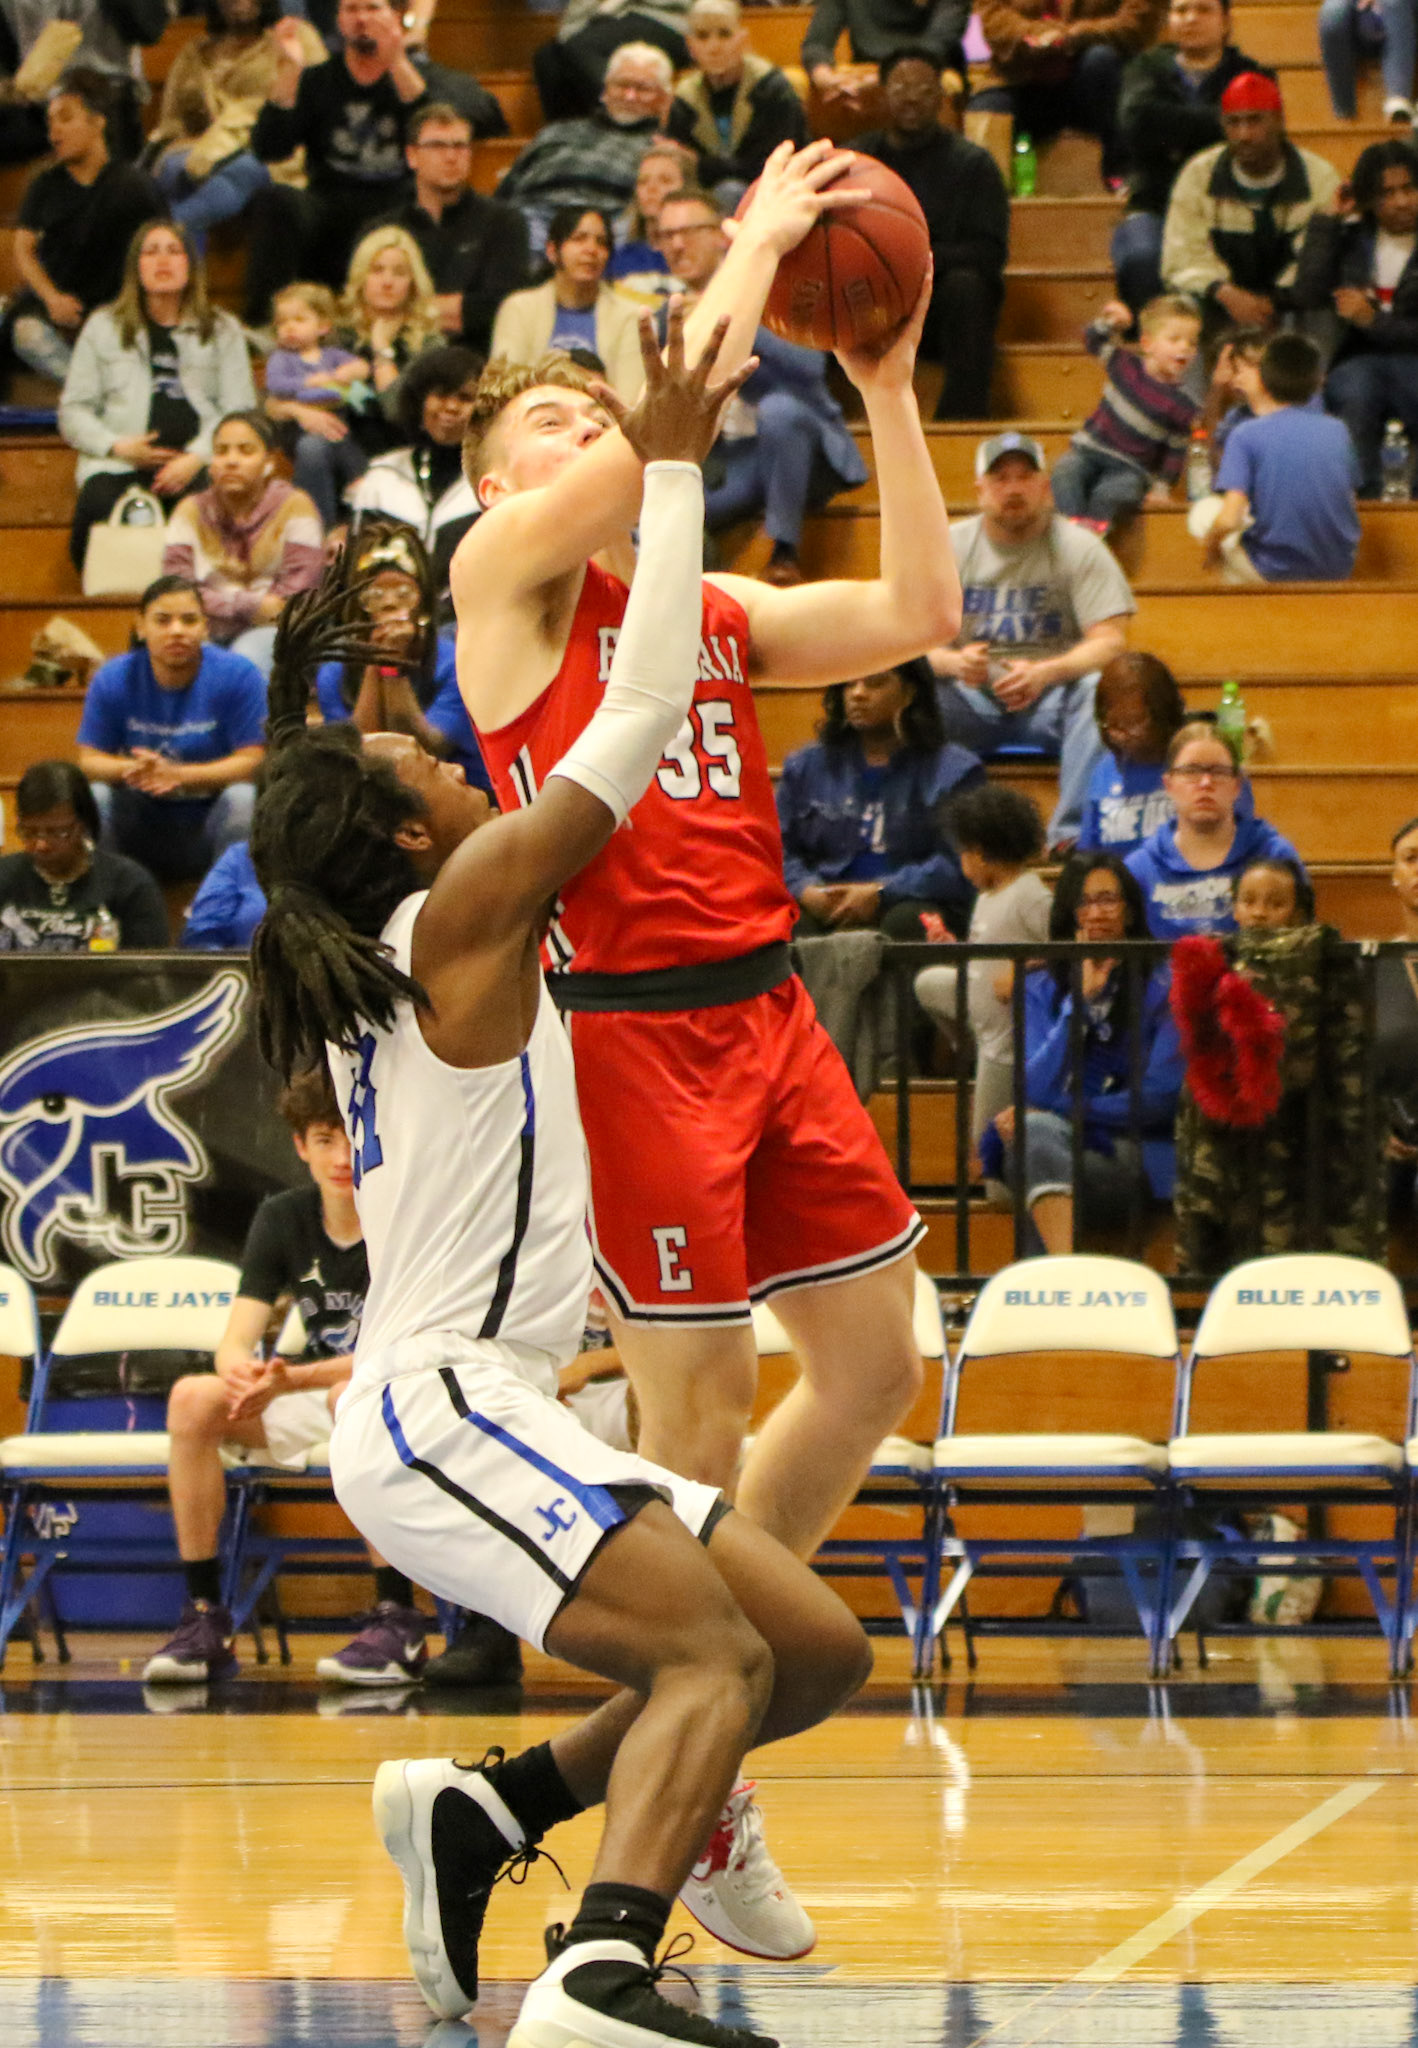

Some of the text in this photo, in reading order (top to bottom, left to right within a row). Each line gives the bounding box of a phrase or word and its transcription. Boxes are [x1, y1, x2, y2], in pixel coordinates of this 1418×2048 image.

[598, 626, 745, 685] ERIA
[656, 698, 742, 800] 35
[56, 1143, 180, 1253] JC
[650, 1225, 694, 1293] E
[93, 1291, 233, 1307] BLUE JAYS
[1004, 1290, 1148, 1306] BLUE JAYS
[1236, 1289, 1381, 1306] BLUE JAYS
[534, 1497, 577, 1541] JC
